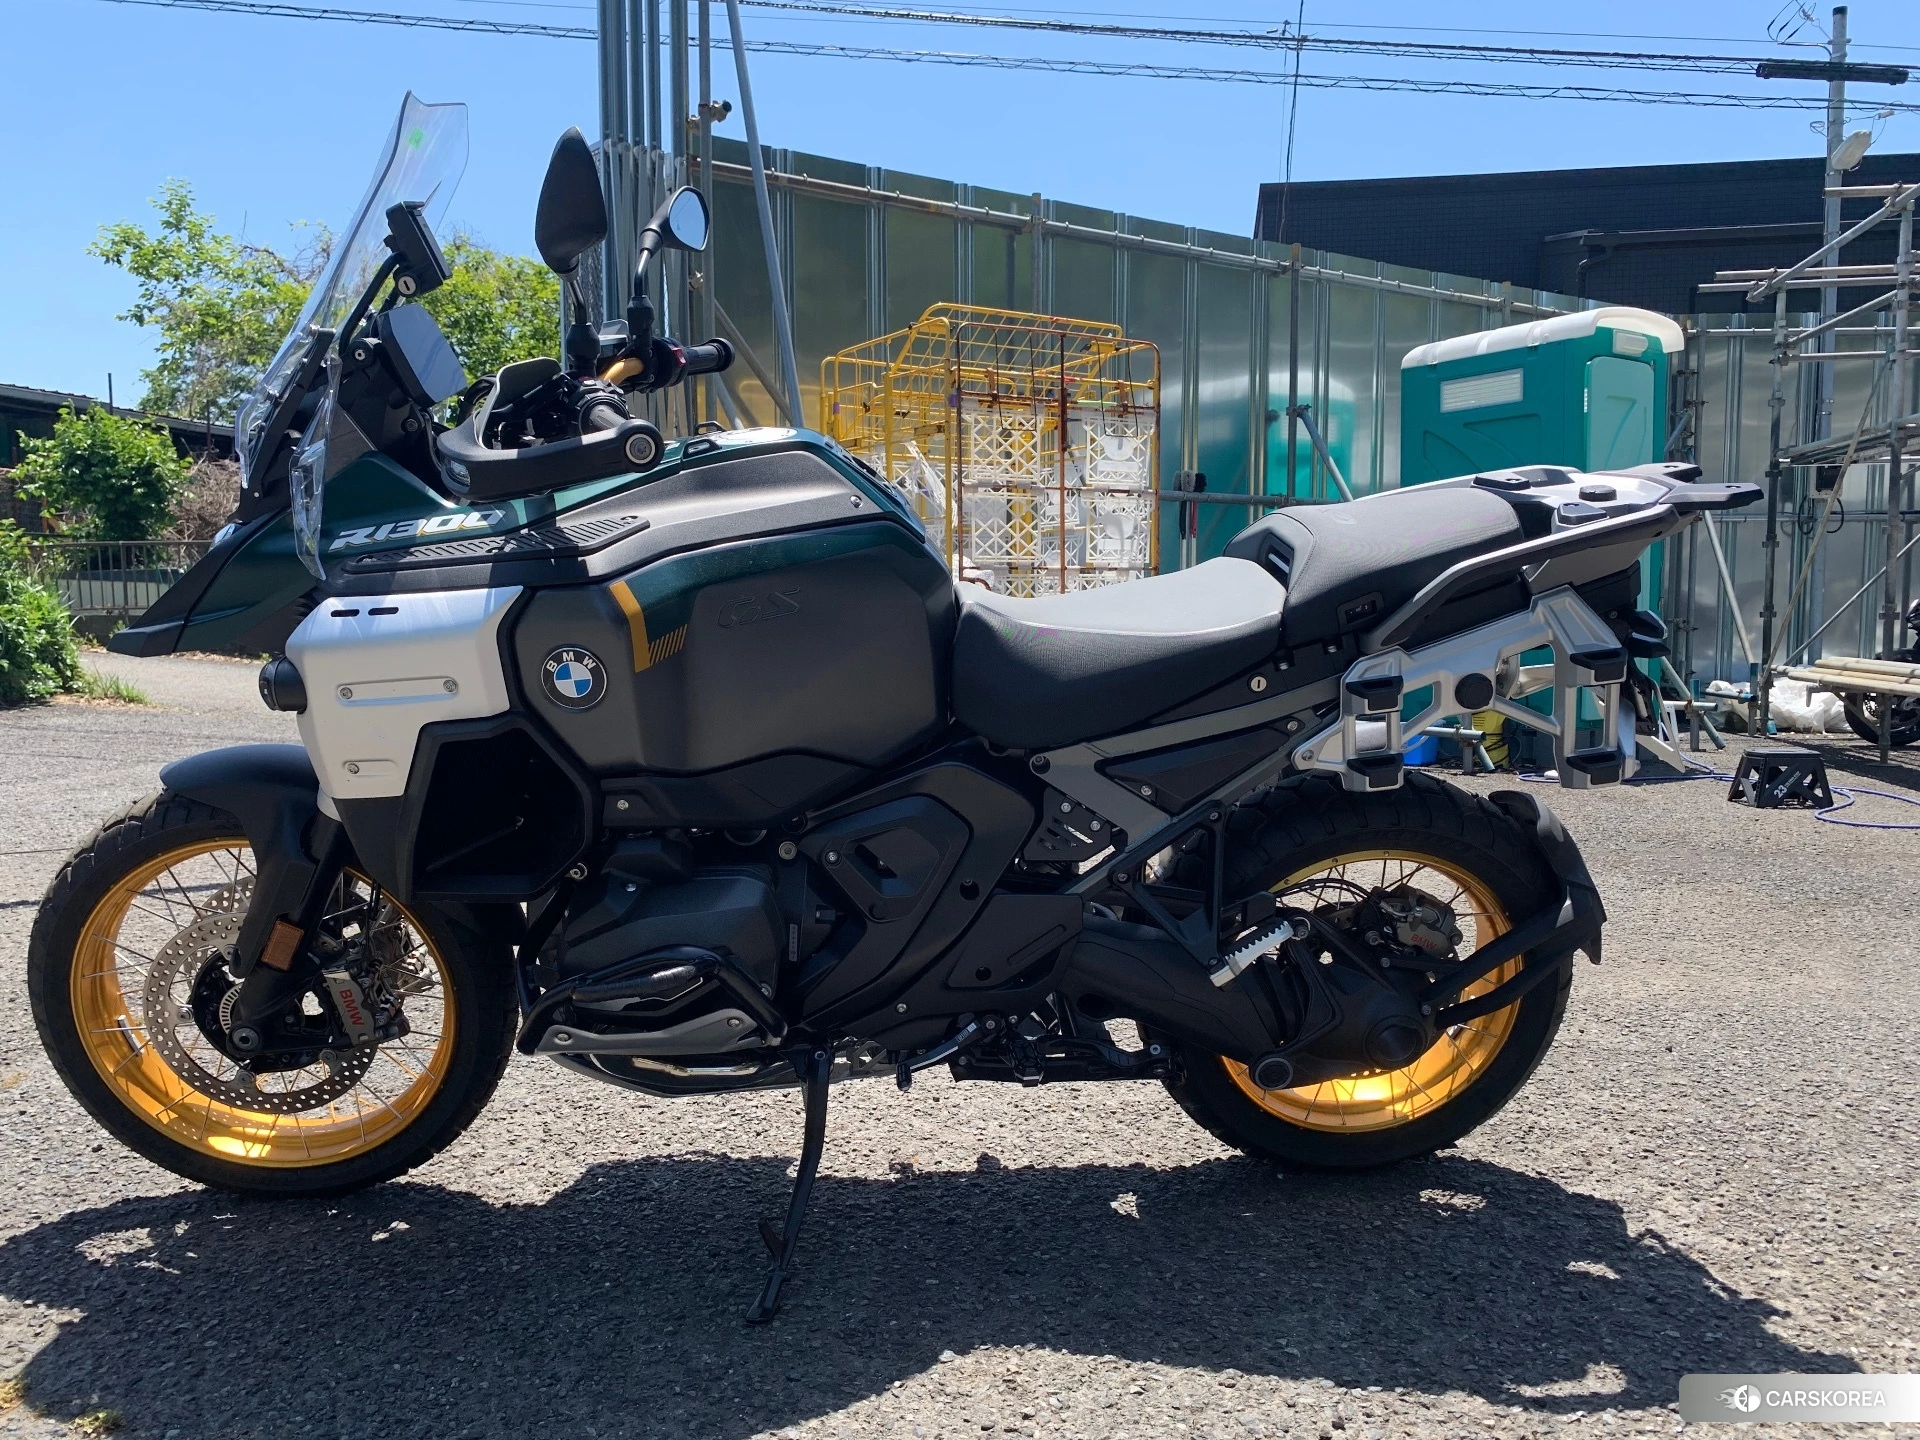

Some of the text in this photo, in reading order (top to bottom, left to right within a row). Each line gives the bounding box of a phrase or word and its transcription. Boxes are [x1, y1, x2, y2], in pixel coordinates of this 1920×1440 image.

[328, 509, 507, 552] R1300
[545, 651, 597, 673] BMW
[1773, 784, 1788, 799] 23
[1411, 933, 1438, 950] BMW
[339, 988, 366, 1026] BMW
